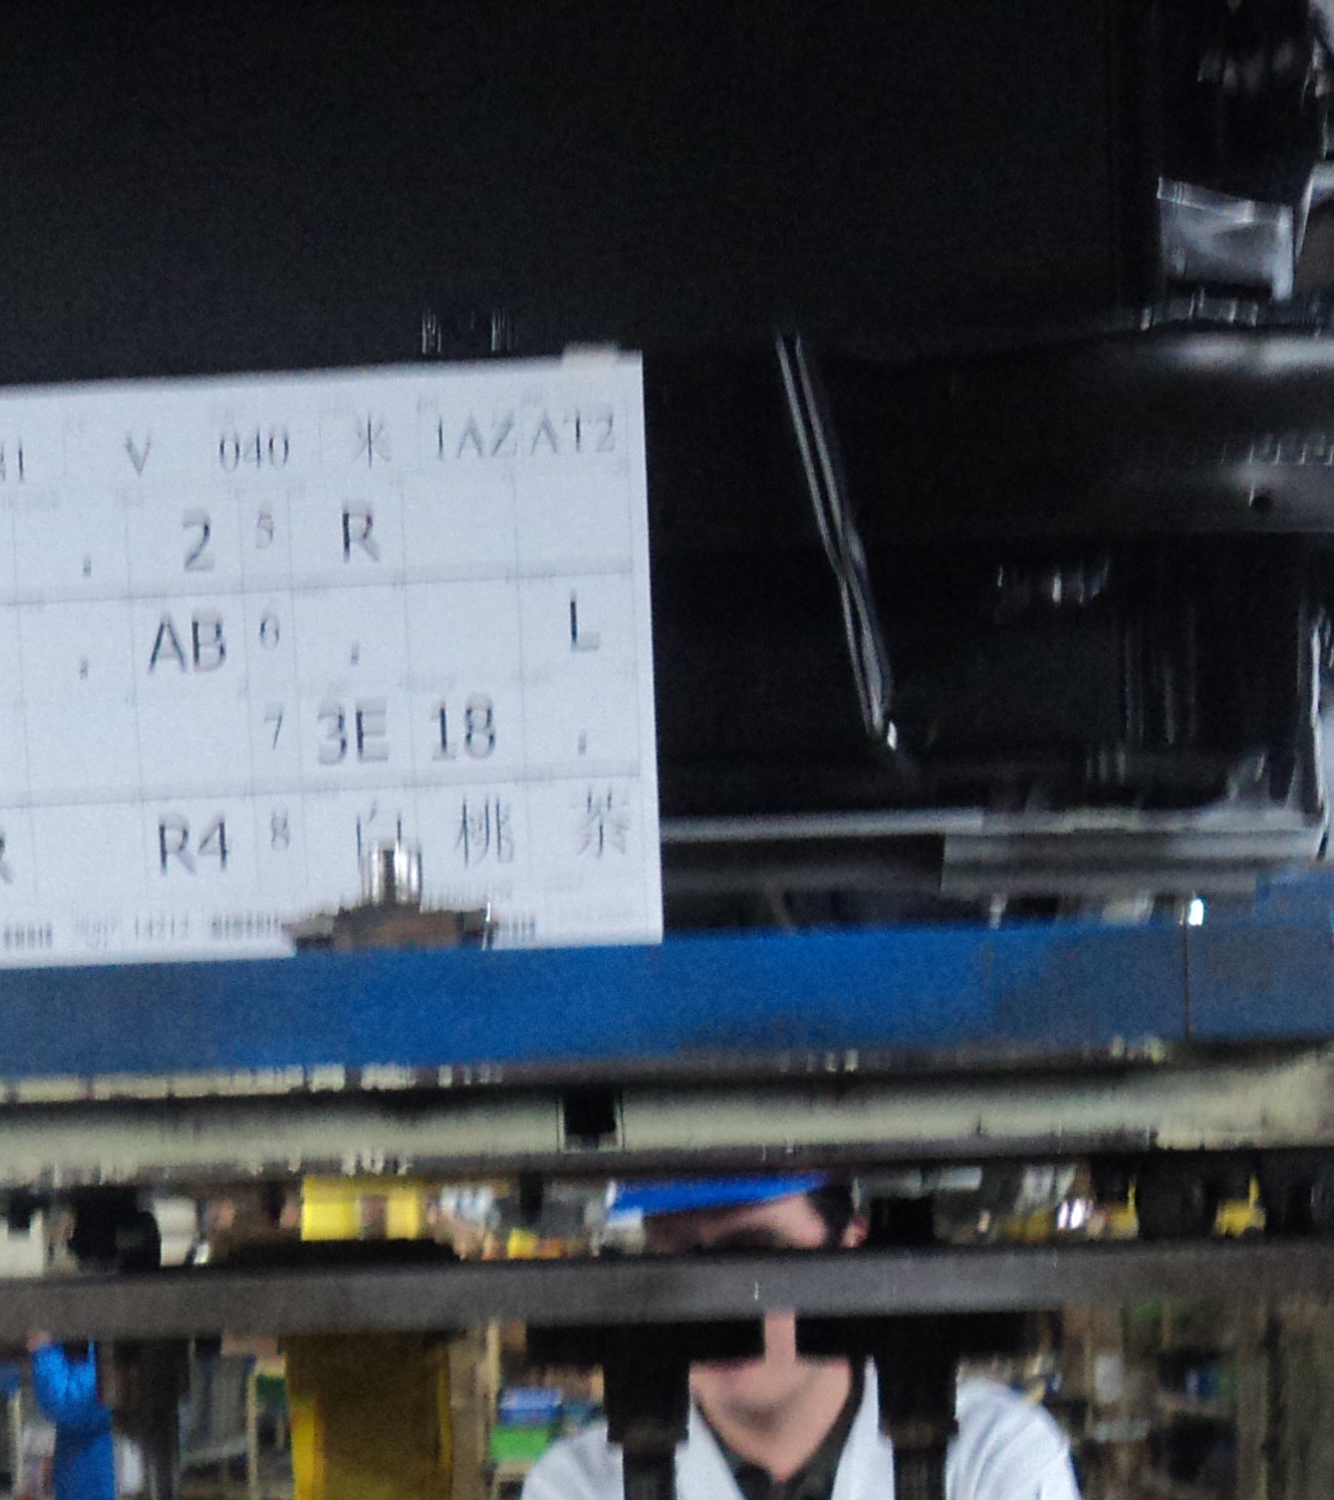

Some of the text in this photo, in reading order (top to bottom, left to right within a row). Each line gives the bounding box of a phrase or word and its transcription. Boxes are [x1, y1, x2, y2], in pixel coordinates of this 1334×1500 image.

[125, 430, 153, 477] V
[219, 424, 290, 474] 040
[182, 506, 215, 573] 2
[341, 500, 380, 564] R
[147, 609, 228, 674] AB
[569, 588, 601, 653] L
[263, 700, 284, 751] 7
[316, 695, 389, 766] 3E
[430, 692, 497, 761] 18
[158, 811, 229, 875] R4
